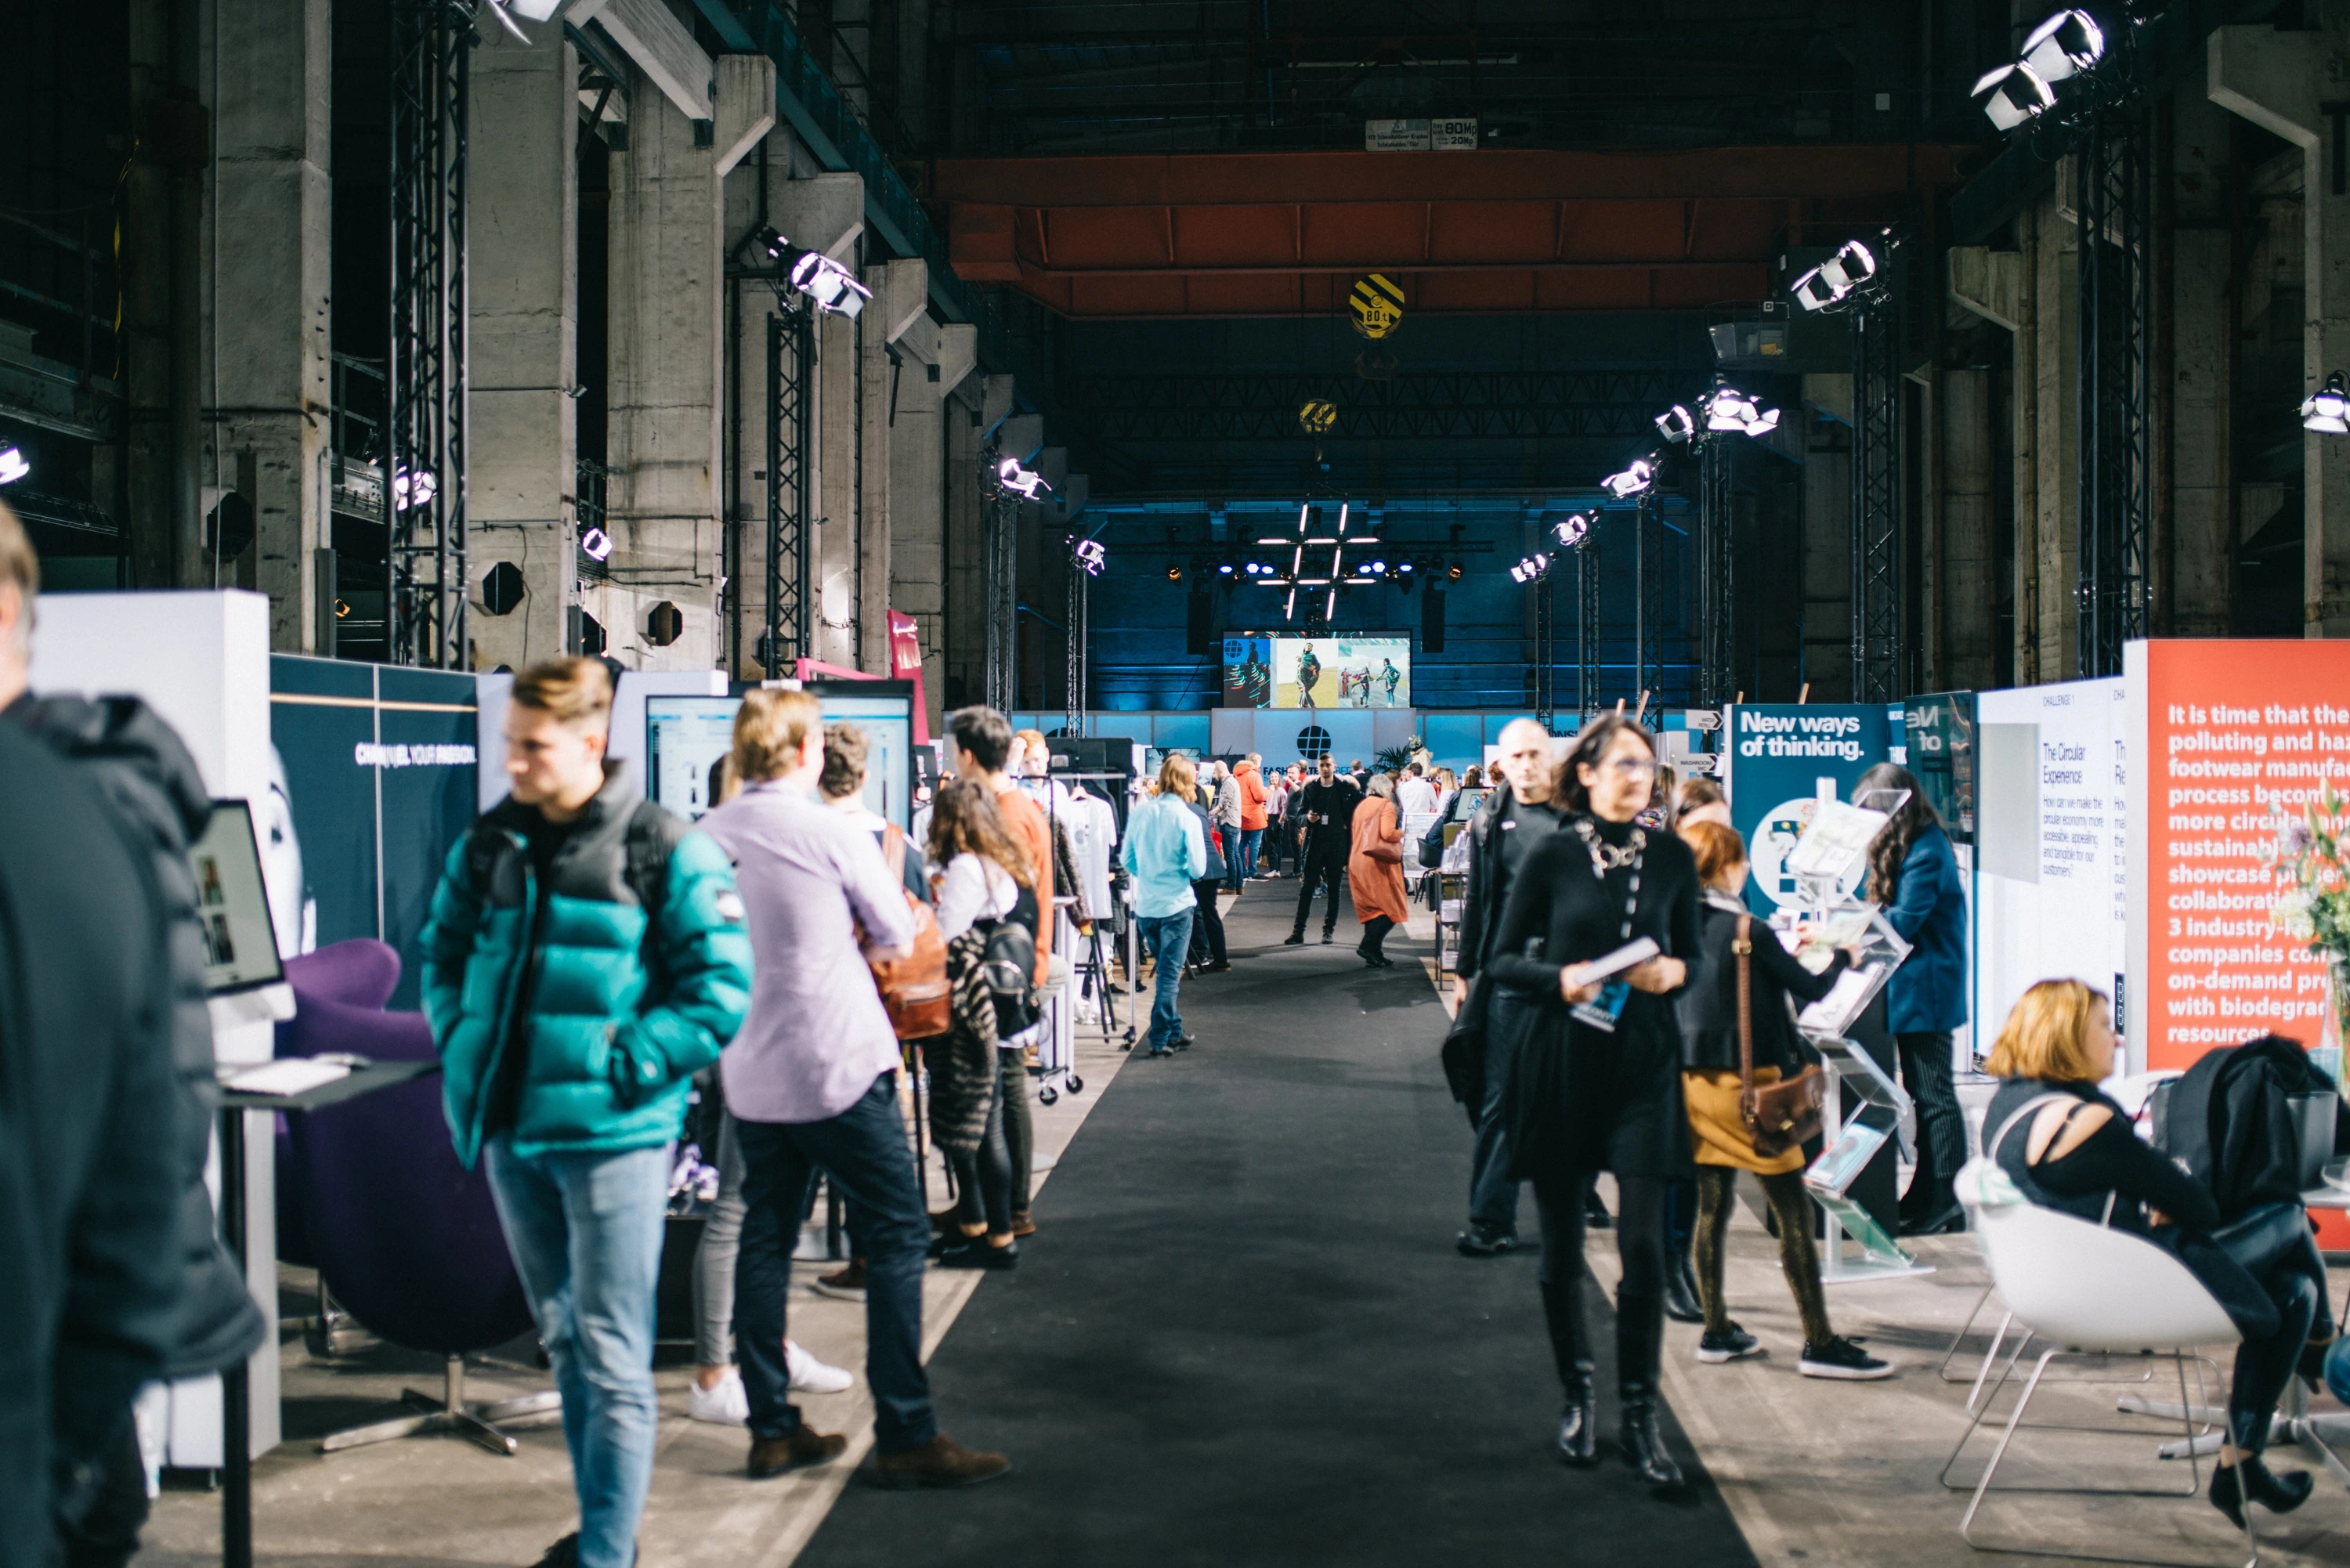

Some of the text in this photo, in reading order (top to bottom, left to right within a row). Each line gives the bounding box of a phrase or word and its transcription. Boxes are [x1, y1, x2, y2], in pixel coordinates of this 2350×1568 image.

[1445, 122, 1477, 136] 80Mp
[1451, 136, 1473, 146] 20Mp
[2043, 694, 2070, 706] CHALLENGE
[2168, 703, 2349, 725] It is time that the
[1740, 710, 1860, 738] New ways
[1739, 735, 1865, 762] of thinking.
[2043, 742, 2085, 761] The Circular
[2168, 730, 2268, 756] polluting
[2272, 730, 2313, 751] and
[2044, 765, 2082, 788] Experience
[2168, 757, 2262, 778] footwear
[2044, 794, 2055, 807] How
[2067, 798, 2076, 808] we
[2077, 796, 2092, 809] make
[2093, 796, 2102, 810] the
[2168, 788, 2251, 808] process
[2043, 811, 2104, 830] circular economy more
[2168, 814, 2226, 831] more
[2071, 831, 2098, 849] appealing
[2114, 833, 2124, 847] the
[2044, 846, 2054, 858] and
[2054, 847, 2076, 863] tangible
[2085, 852, 2095, 862] our
[2168, 864, 2271, 883] showcase
[2168, 917, 2182, 938] 3
[2167, 945, 2284, 967] companies
[2167, 970, 2293, 990] on-demand
[2167, 996, 2216, 1017] with
